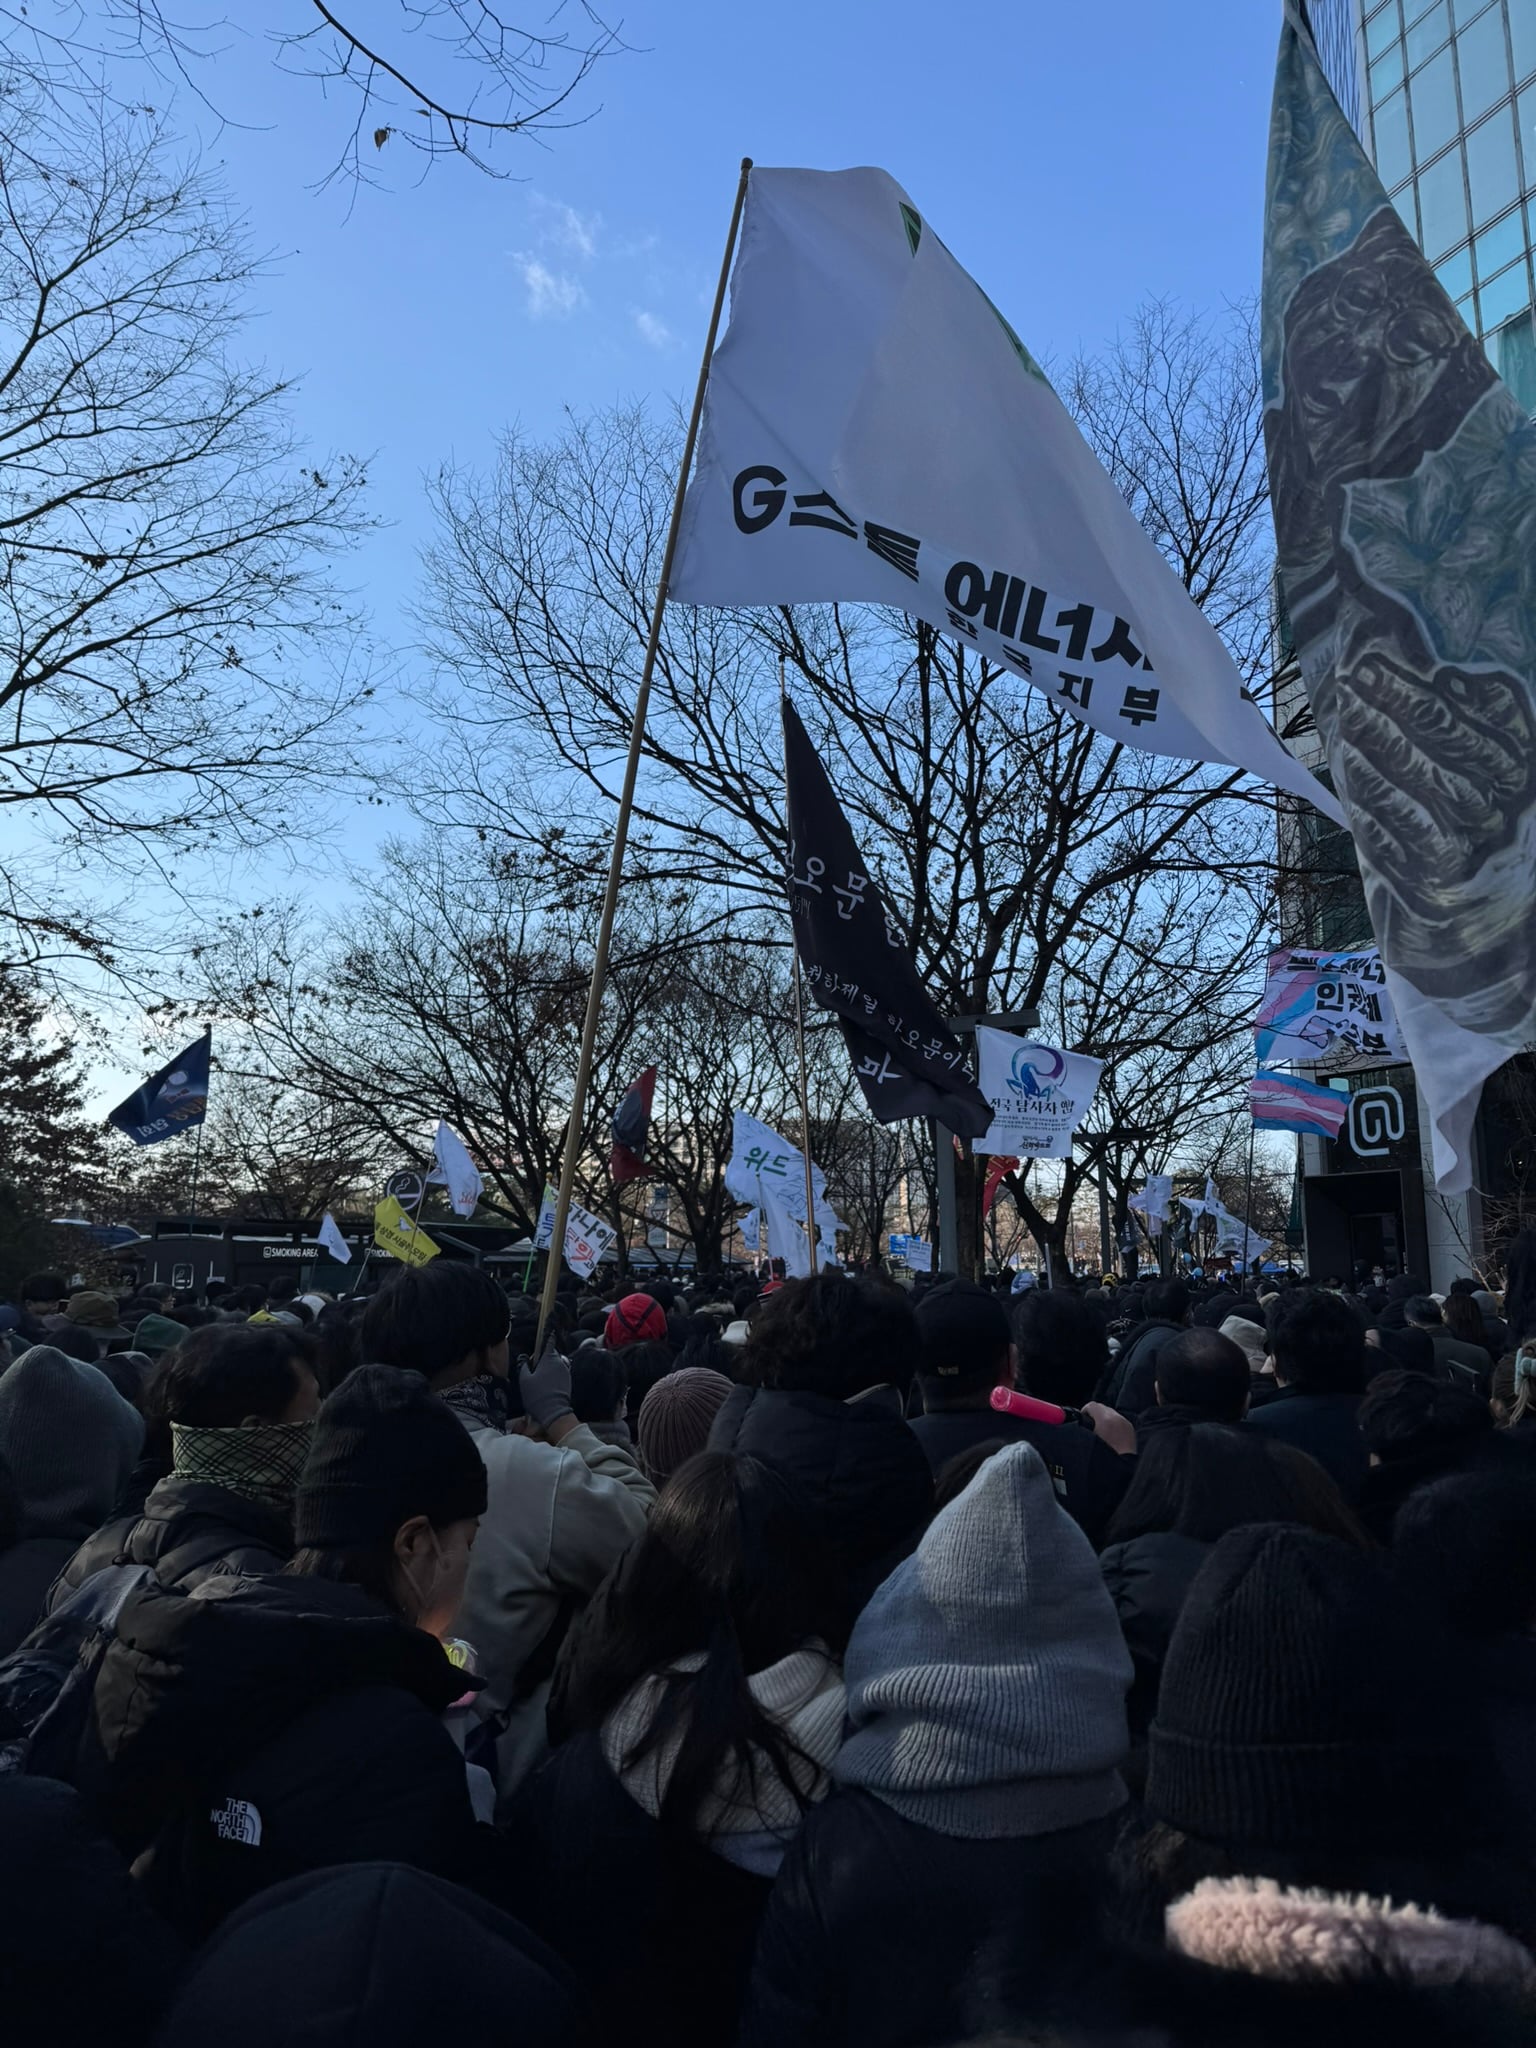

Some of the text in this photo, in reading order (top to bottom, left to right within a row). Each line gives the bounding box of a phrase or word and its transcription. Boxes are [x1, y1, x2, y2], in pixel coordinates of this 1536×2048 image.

[1016, 1099, 1057, 1115] 탐사자
[743, 1146, 790, 1177] 위드
[271, 1247, 319, 1258] SMOKING AREA
[226, 1797, 247, 1815] THE
[210, 1808, 246, 1828] NORTH
[218, 1824, 244, 1841] FACE
